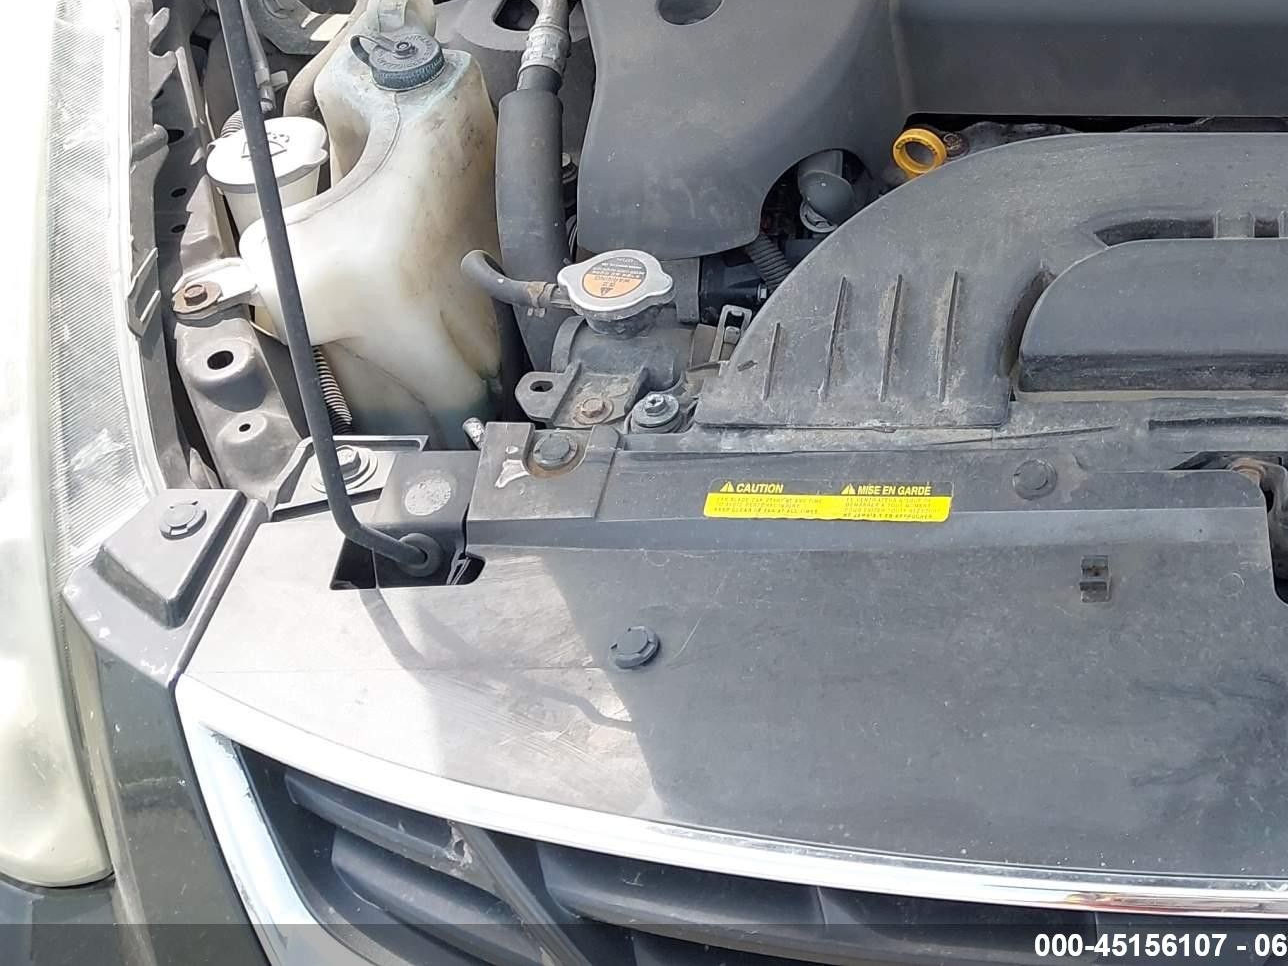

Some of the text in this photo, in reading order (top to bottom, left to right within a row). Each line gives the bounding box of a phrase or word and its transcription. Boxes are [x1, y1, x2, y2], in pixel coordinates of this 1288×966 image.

[736, 483, 785, 494] CAUTION
[857, 485, 882, 495] MISE
[882, 485, 896, 495] EN
